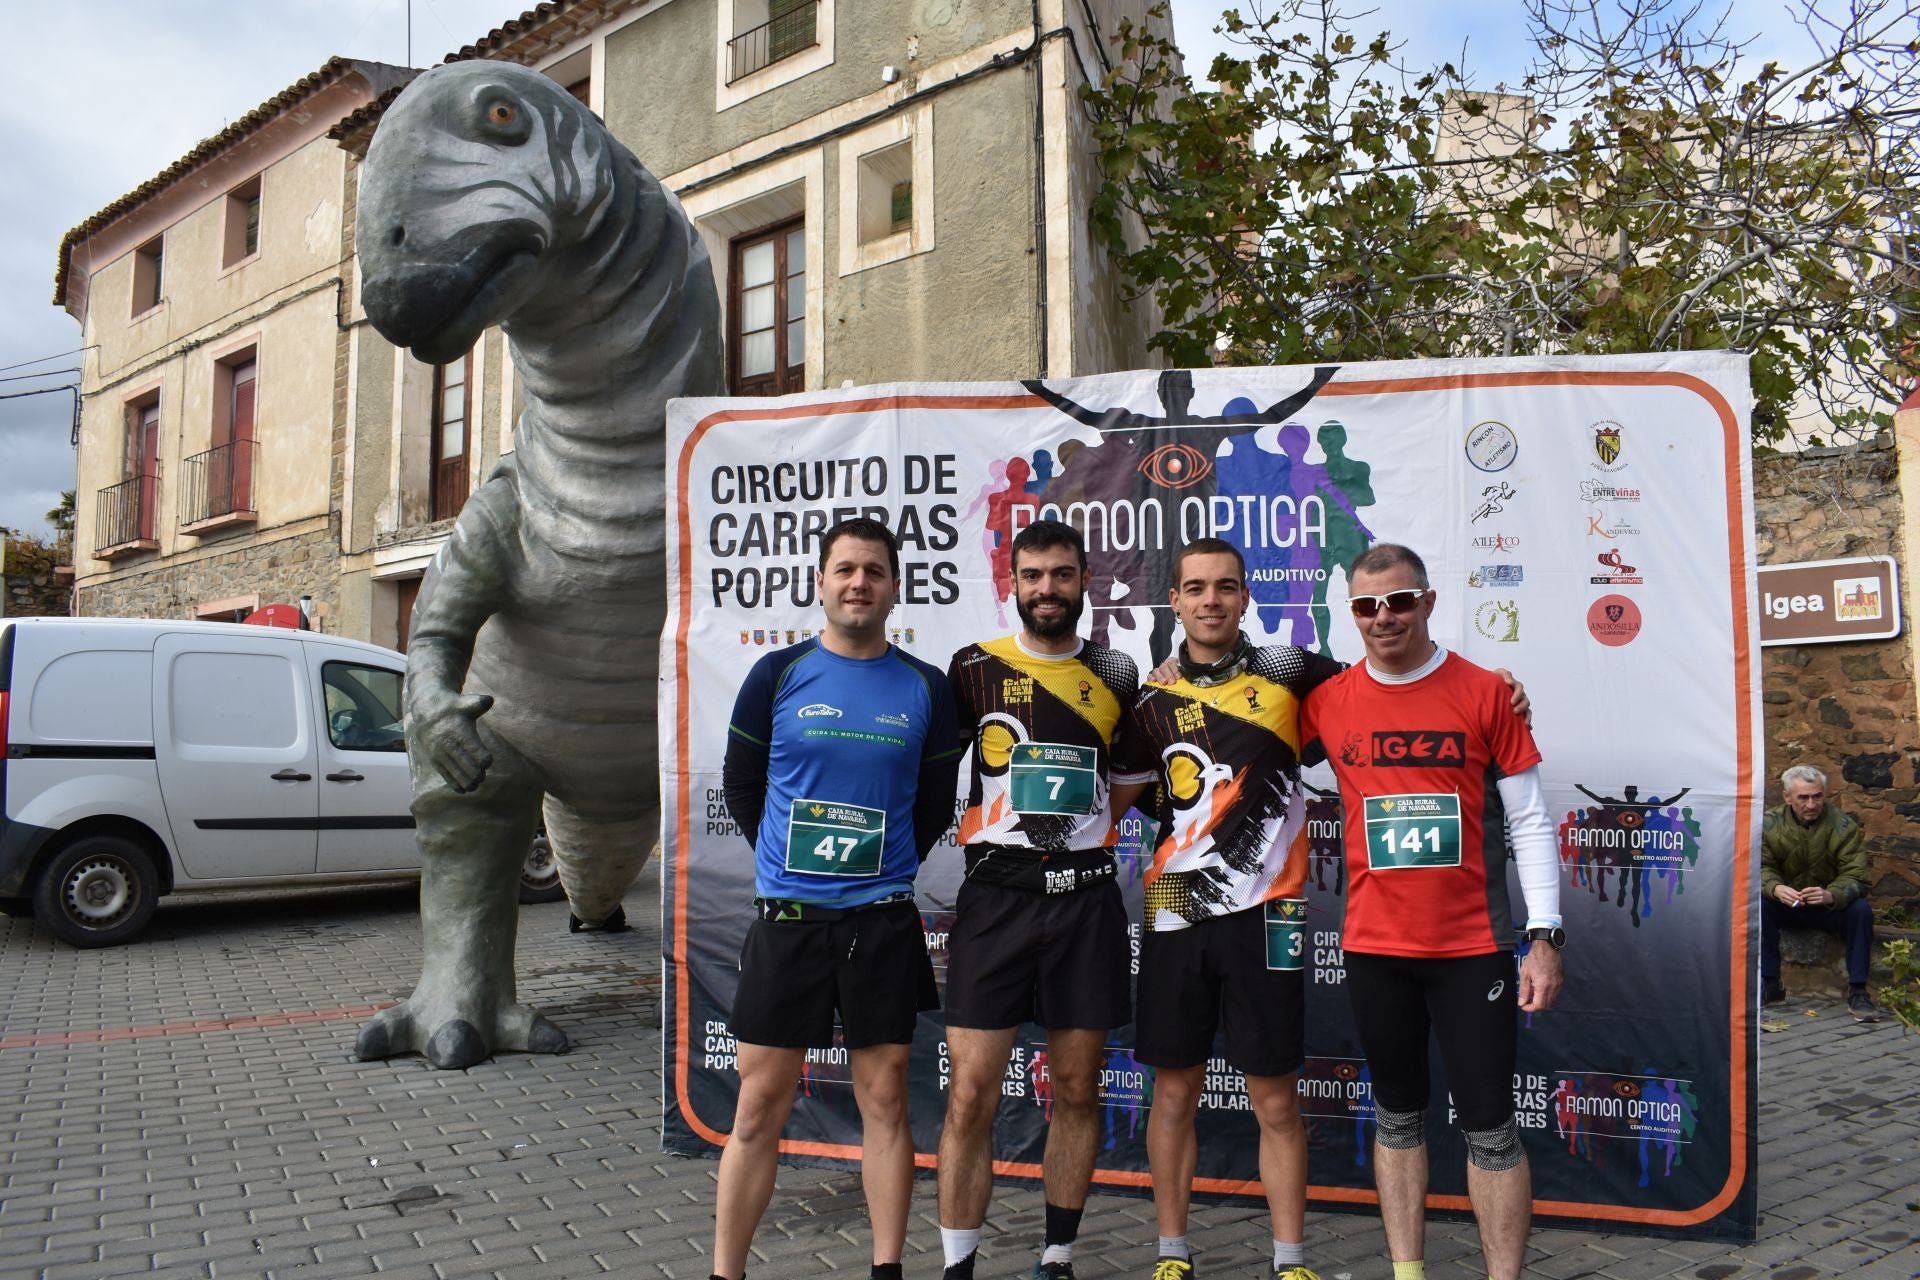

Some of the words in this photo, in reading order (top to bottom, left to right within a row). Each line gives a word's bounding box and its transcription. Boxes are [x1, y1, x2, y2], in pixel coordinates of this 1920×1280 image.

[1472, 426, 1494, 448] RINCON
[1484, 441, 1512, 468] ATLETISMO
[711, 456, 888, 504] CIRCUITO
[904, 454, 958, 495] DE
[1180, 495, 1326, 548] OPTICA
[711, 562, 960, 608] POPUES
[1252, 568, 1327, 582] AUDITIVO
[1765, 593, 1824, 619] Igea
[805, 708, 836, 716] EuroTaller
[1055, 754, 1081, 762] NAVARRA
[1046, 776, 1065, 800] 7
[837, 814, 867, 824] NAVARRA
[844, 810, 865, 818] RURAL
[814, 836, 858, 862] 47
[1382, 827, 1440, 854] 141
[1568, 828, 1625, 848] RAMON
[1631, 830, 1683, 850] OPTICA
[804, 1048, 848, 1065] AMON
[1297, 1079, 1341, 1099] AMON
[1526, 1074, 1548, 1090] DE
[1198, 1093, 1254, 1110] PULAR
[1566, 1096, 1622, 1117] RAMON
[1628, 1100, 1680, 1122] OPTICA
[1653, 1126, 1680, 1134] AUDITIVO
